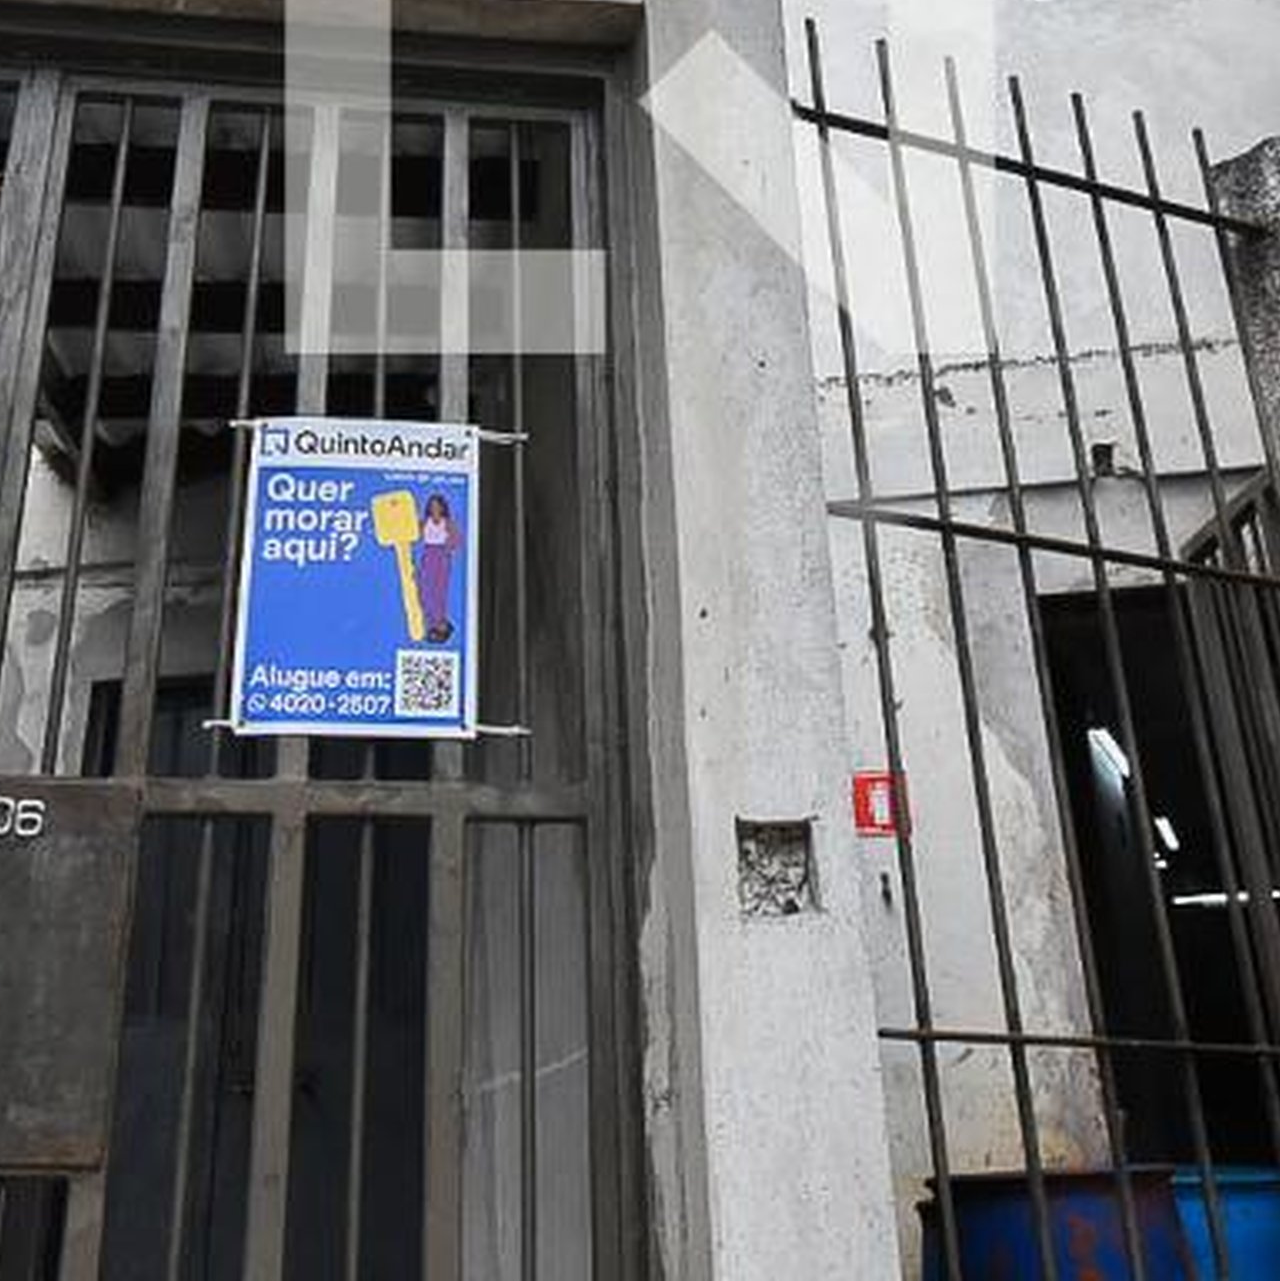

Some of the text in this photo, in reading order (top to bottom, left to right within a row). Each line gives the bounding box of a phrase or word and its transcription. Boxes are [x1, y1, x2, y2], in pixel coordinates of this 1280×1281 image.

[294, 429, 469, 461] QuintoAndar
[267, 472, 355, 503] Quer
[264, 507, 369, 532] morar
[262, 532, 360, 569] aqui?
[249, 664, 393, 692] Alugue em:
